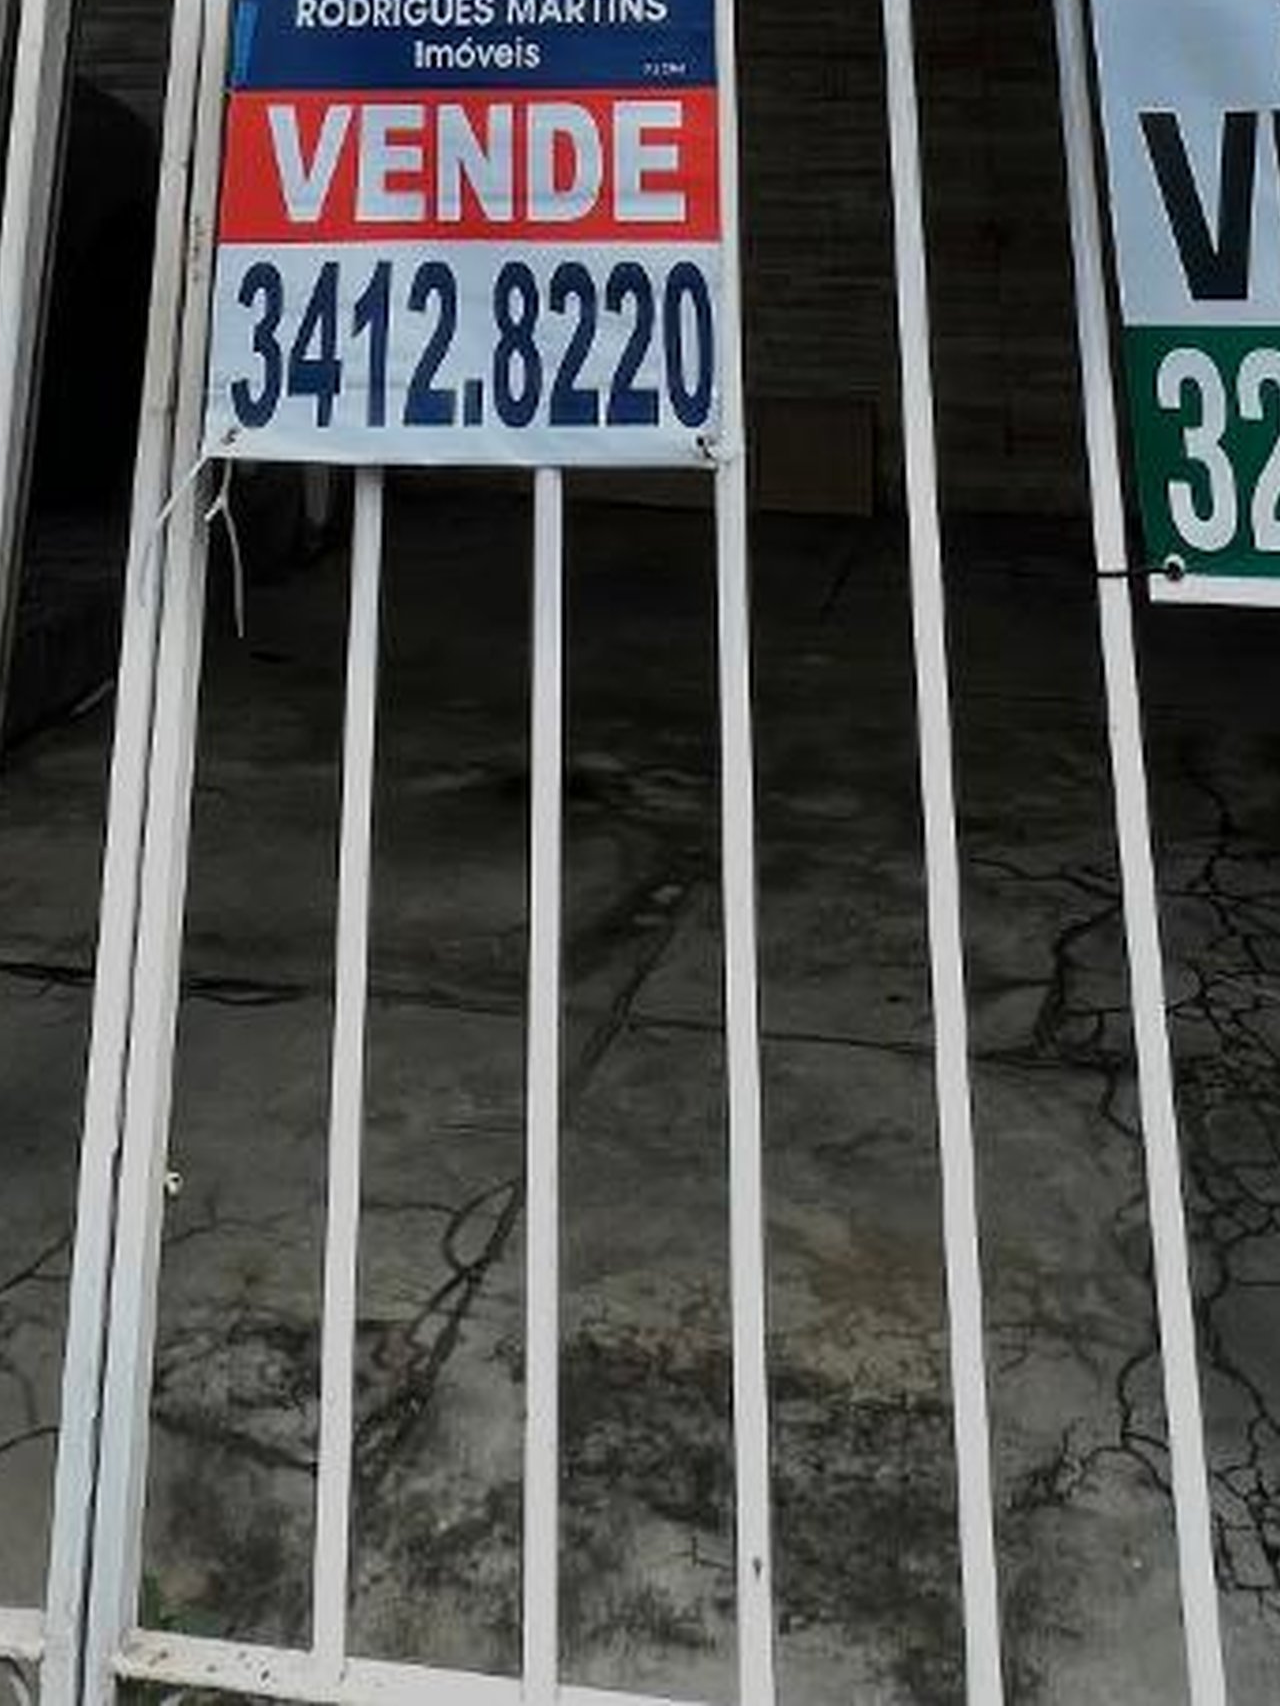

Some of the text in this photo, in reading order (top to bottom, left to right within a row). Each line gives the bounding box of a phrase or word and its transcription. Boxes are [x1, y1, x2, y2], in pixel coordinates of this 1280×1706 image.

[414, 39, 542, 71] Imóveis
[267, 99, 687, 224] VENDE
[230, 260, 716, 429] 3412.8220
